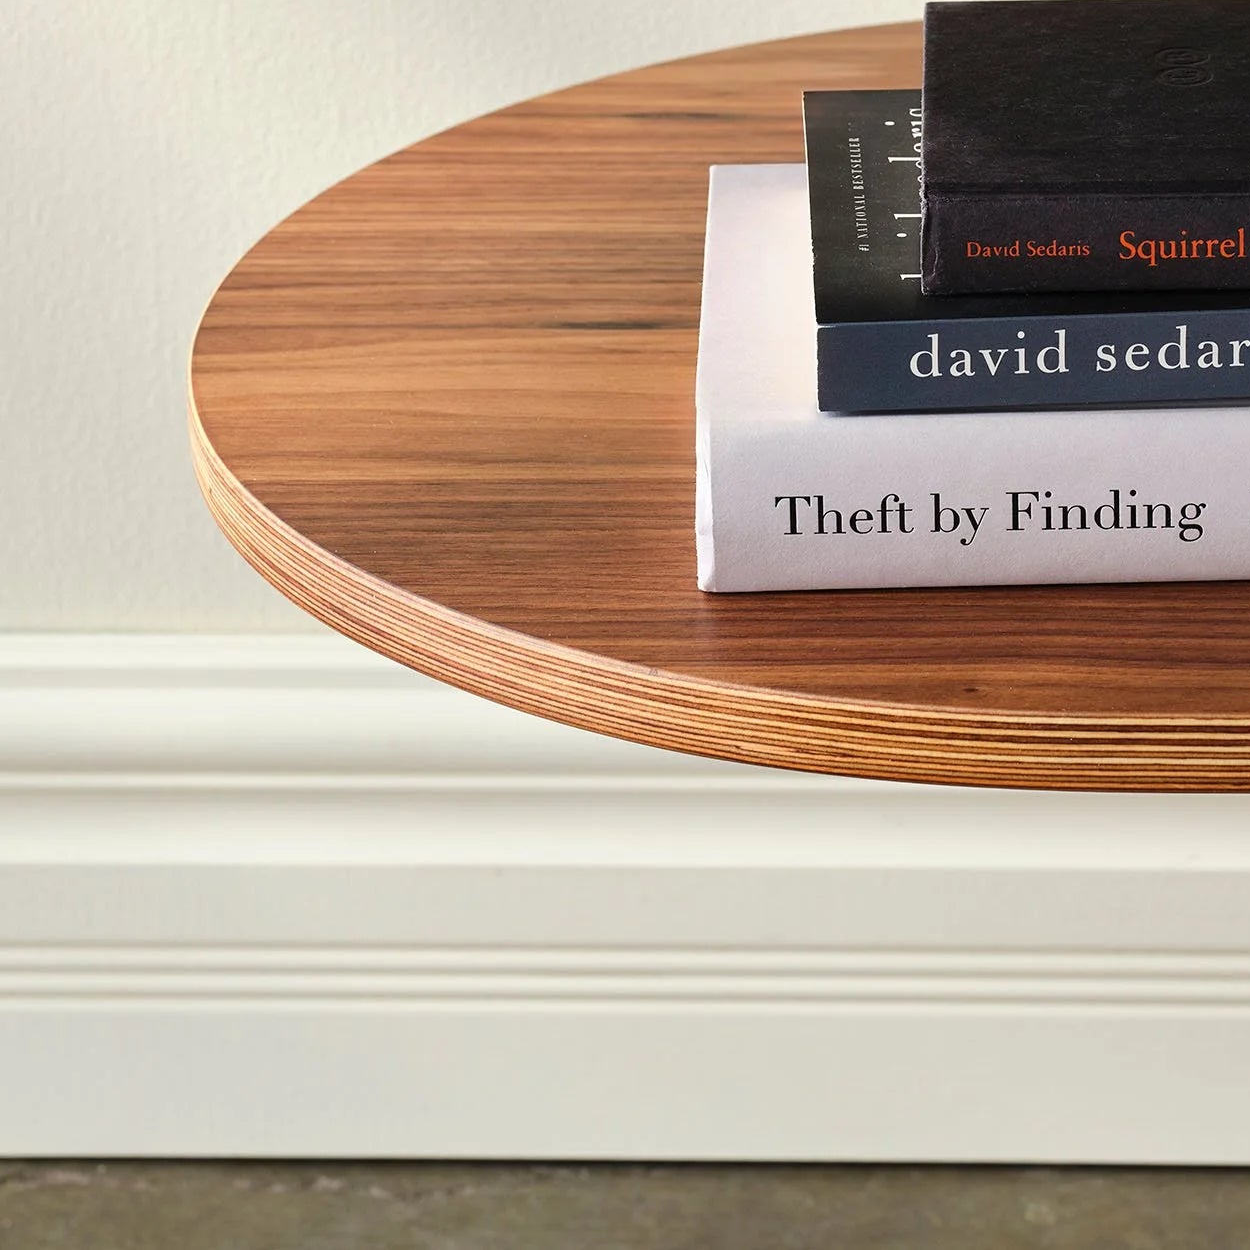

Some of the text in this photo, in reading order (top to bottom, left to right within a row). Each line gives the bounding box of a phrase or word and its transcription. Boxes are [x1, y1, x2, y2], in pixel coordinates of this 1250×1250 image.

[848, 137, 865, 190] BESTSELLER
[852, 195, 868, 239] NATIONAL
[966, 240, 1090, 257] David Sedaris
[1119, 227, 1246, 266] Squirrel
[909, 329, 1069, 377] david
[774, 489, 1207, 546] Theft by Finding
